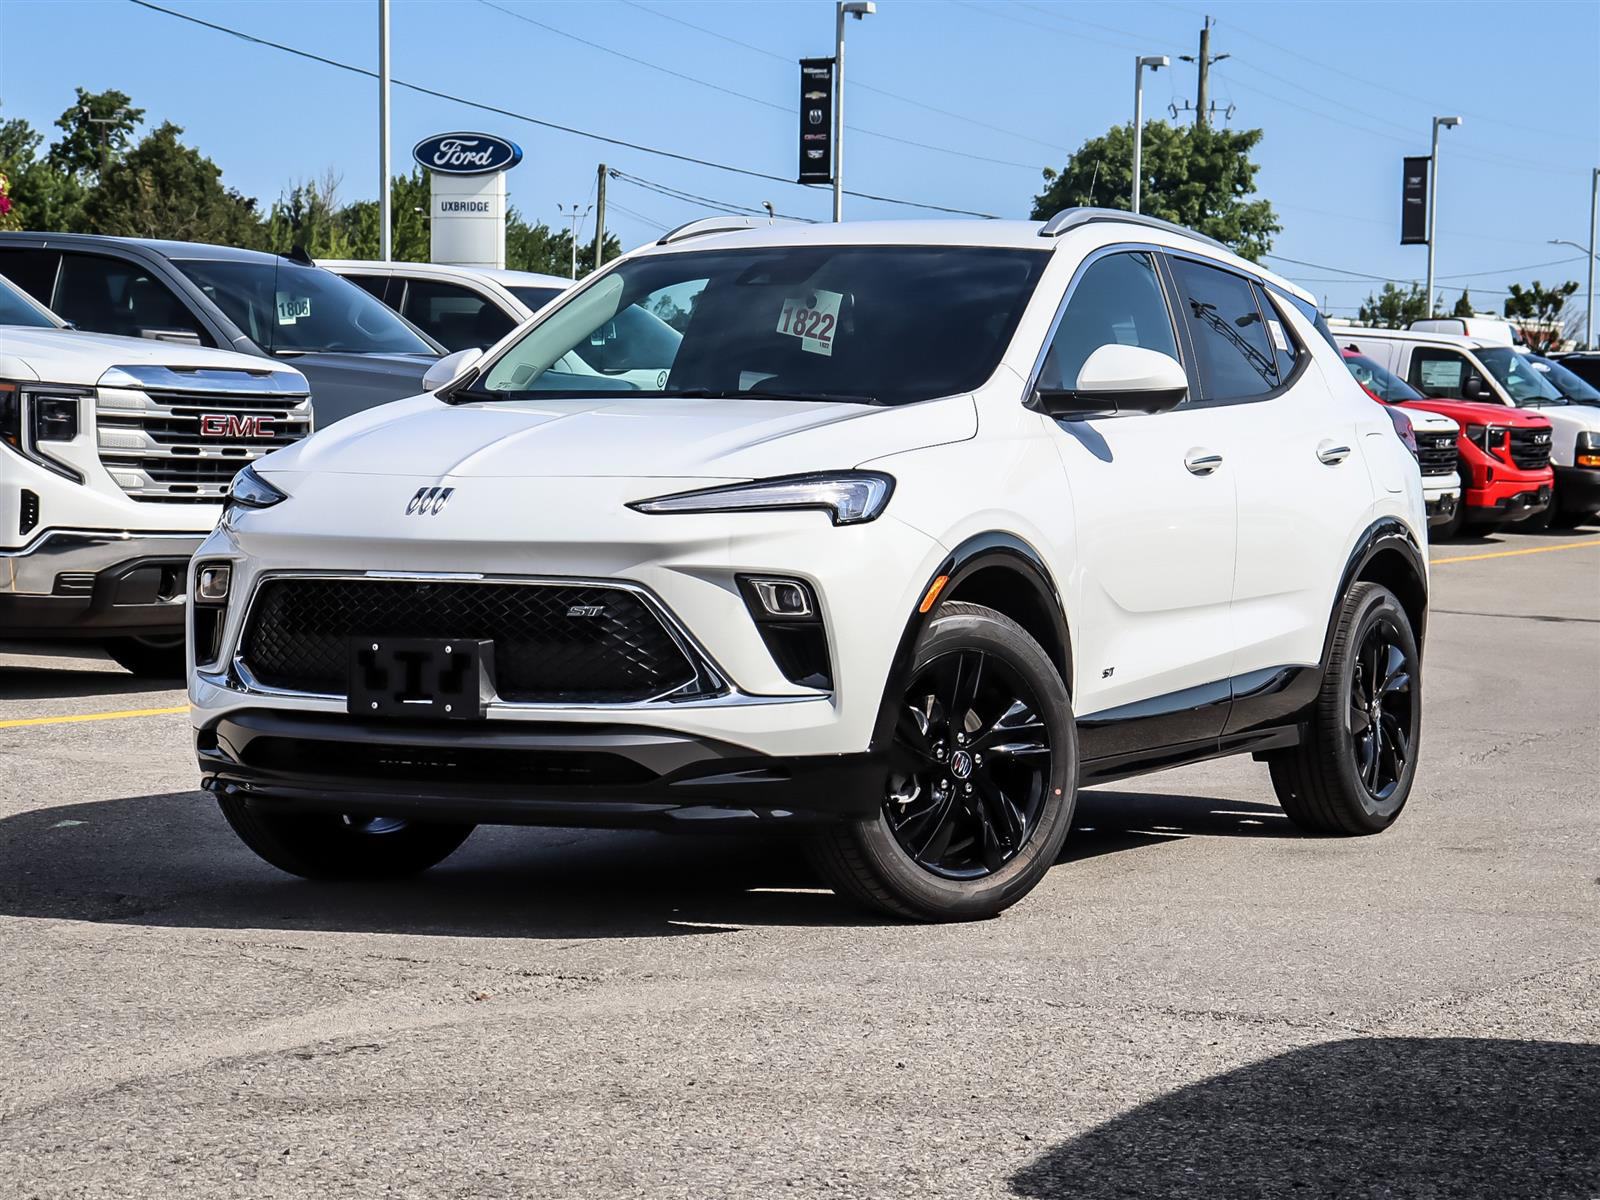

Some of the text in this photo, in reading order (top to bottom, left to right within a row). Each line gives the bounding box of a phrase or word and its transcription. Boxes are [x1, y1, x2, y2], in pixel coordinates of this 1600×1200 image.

[433, 139, 494, 165] Ford
[441, 201, 489, 212] UXBRIDGE
[278, 302, 309, 316] 1806
[781, 305, 835, 342] 1822
[200, 413, 276, 437] GMC
[566, 605, 605, 616] ST
